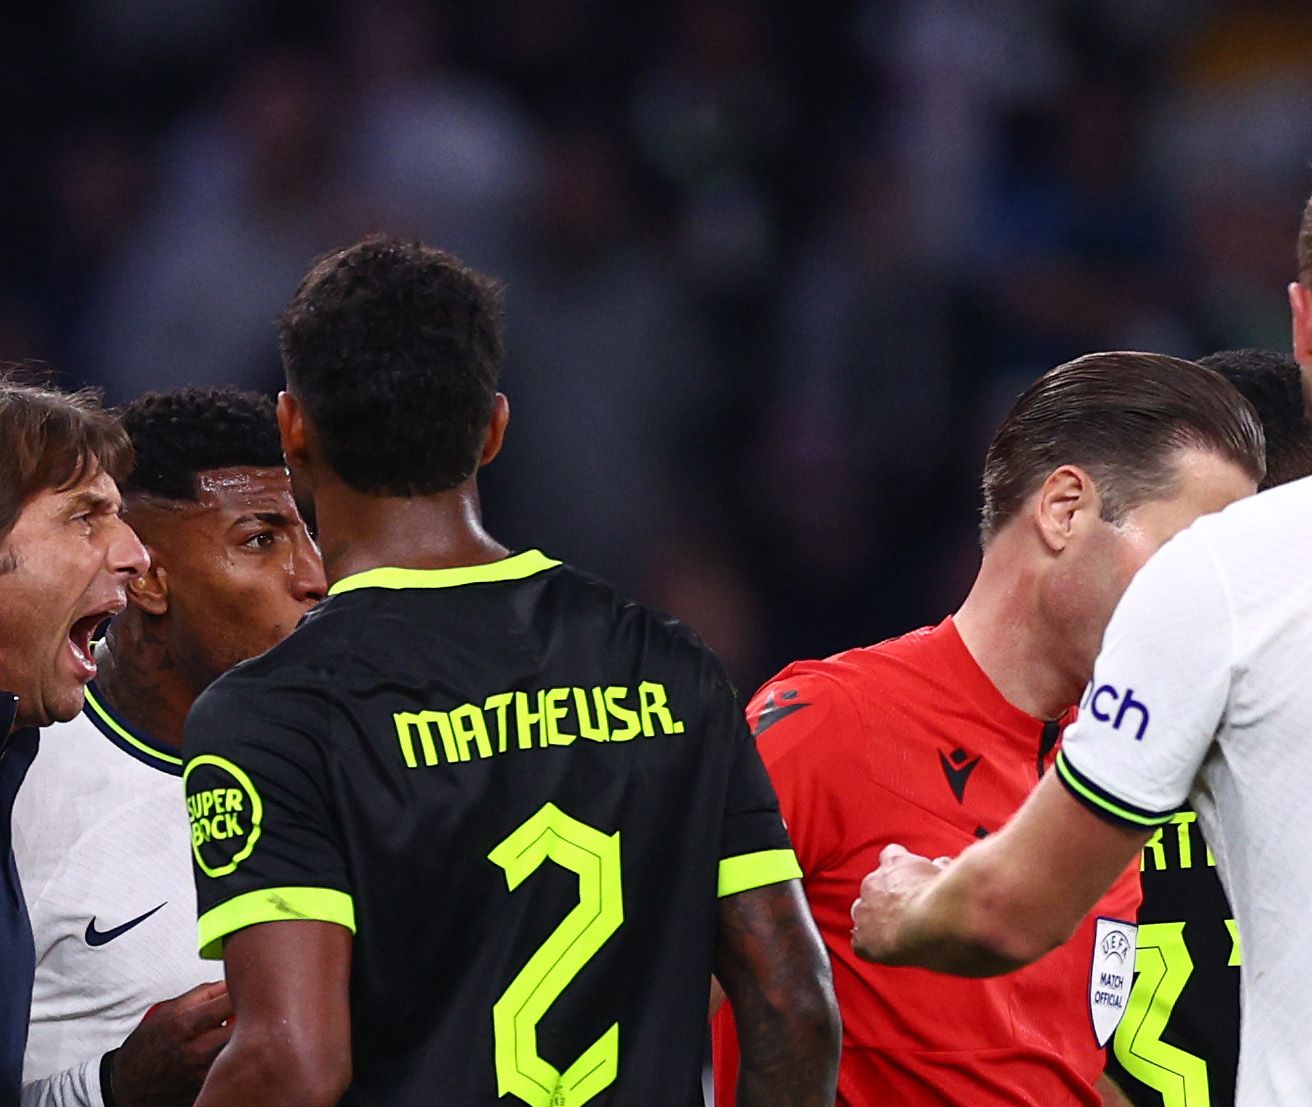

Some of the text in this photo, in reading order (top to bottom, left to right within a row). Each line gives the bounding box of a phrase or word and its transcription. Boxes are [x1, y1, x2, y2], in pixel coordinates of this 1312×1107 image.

[1083, 683, 1150, 741] ch
[187, 788, 243, 823] SUPER
[192, 812, 244, 848] BOCK
[1103, 935, 1129, 959] UEFA
[1100, 972, 1125, 989] MATCH
[1094, 990, 1123, 1009] OFFICIAL
